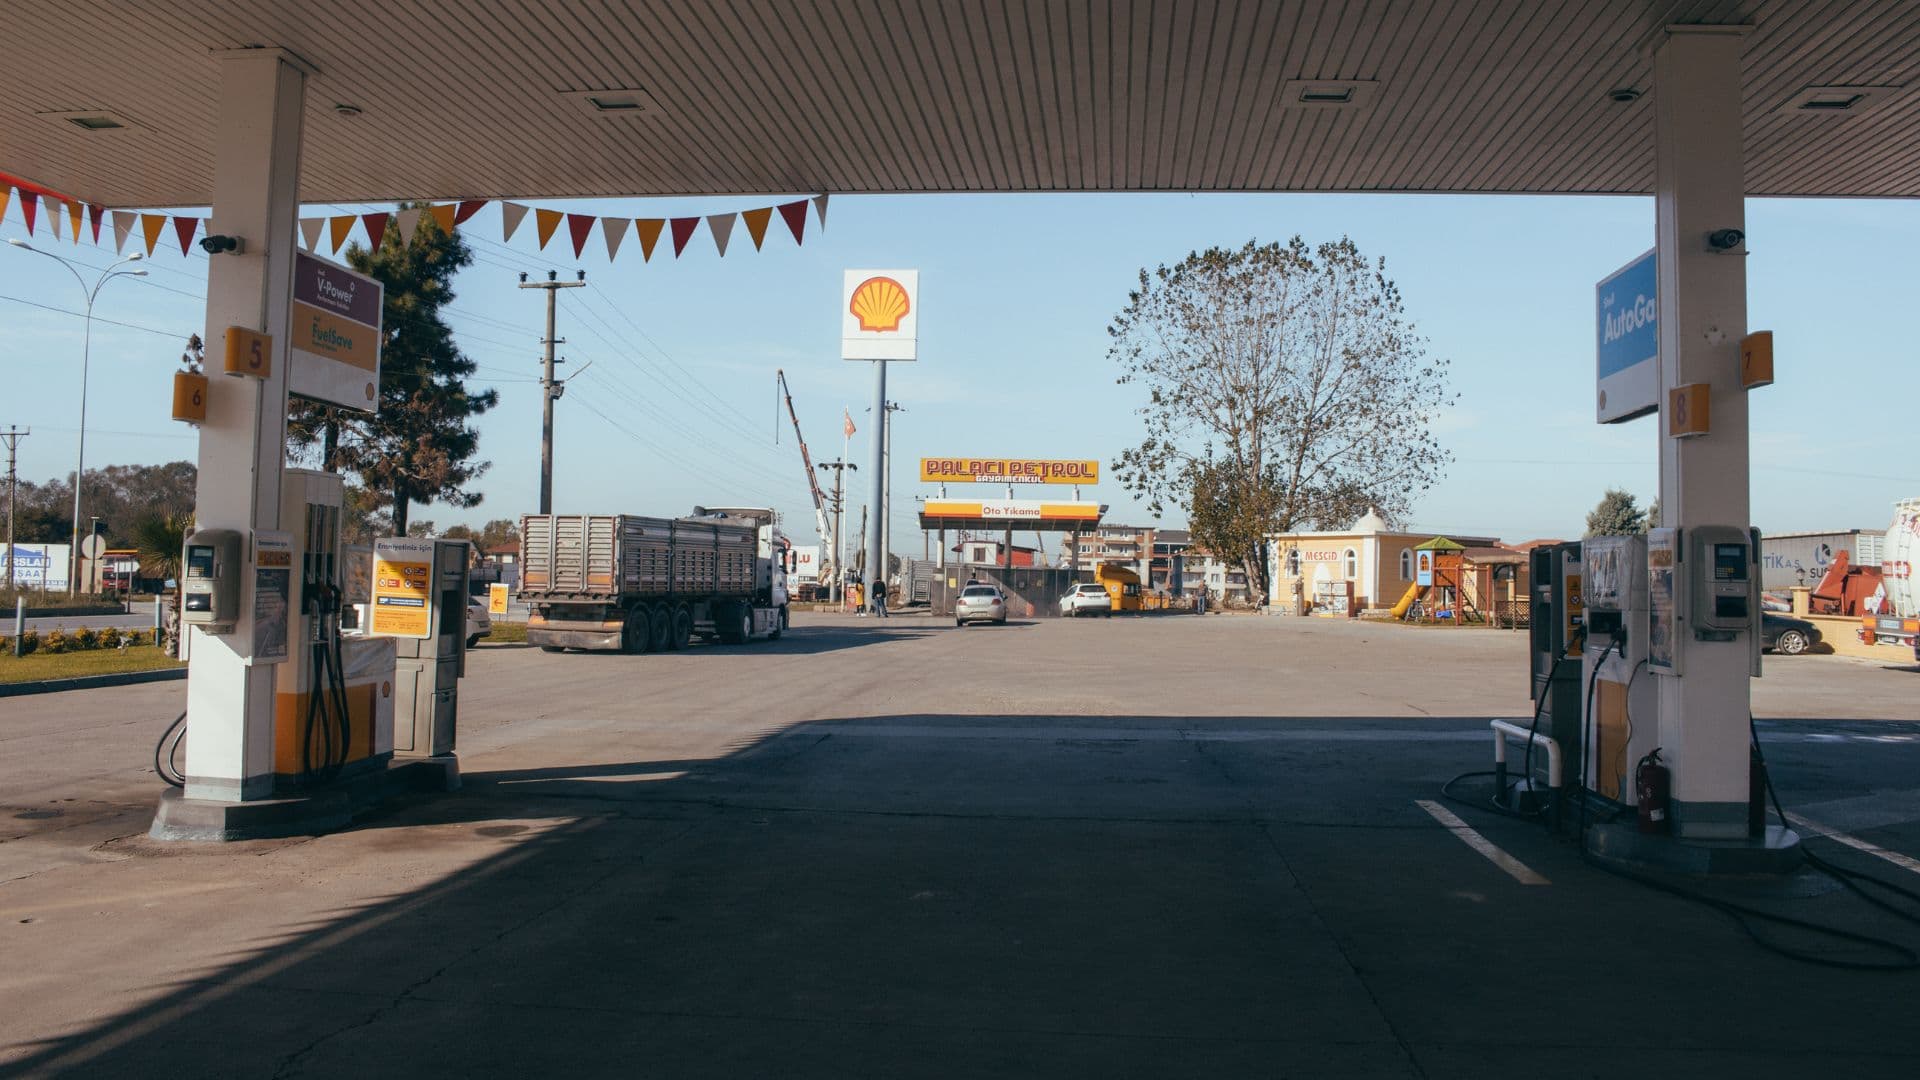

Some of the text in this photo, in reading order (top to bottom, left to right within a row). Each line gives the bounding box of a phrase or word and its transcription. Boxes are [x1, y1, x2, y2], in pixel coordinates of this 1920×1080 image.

[317, 277, 353, 304] V-Power
[1604, 294, 1656, 345] AutoGa
[312, 322, 353, 351] FuelSave
[249, 339, 262, 369] 5
[1744, 351, 1752, 369] 7
[192, 389, 201, 406] 6
[1676, 393, 1686, 426] 8
[1009, 462, 1095, 478] PETROL
[983, 506, 1001, 516] Oto
